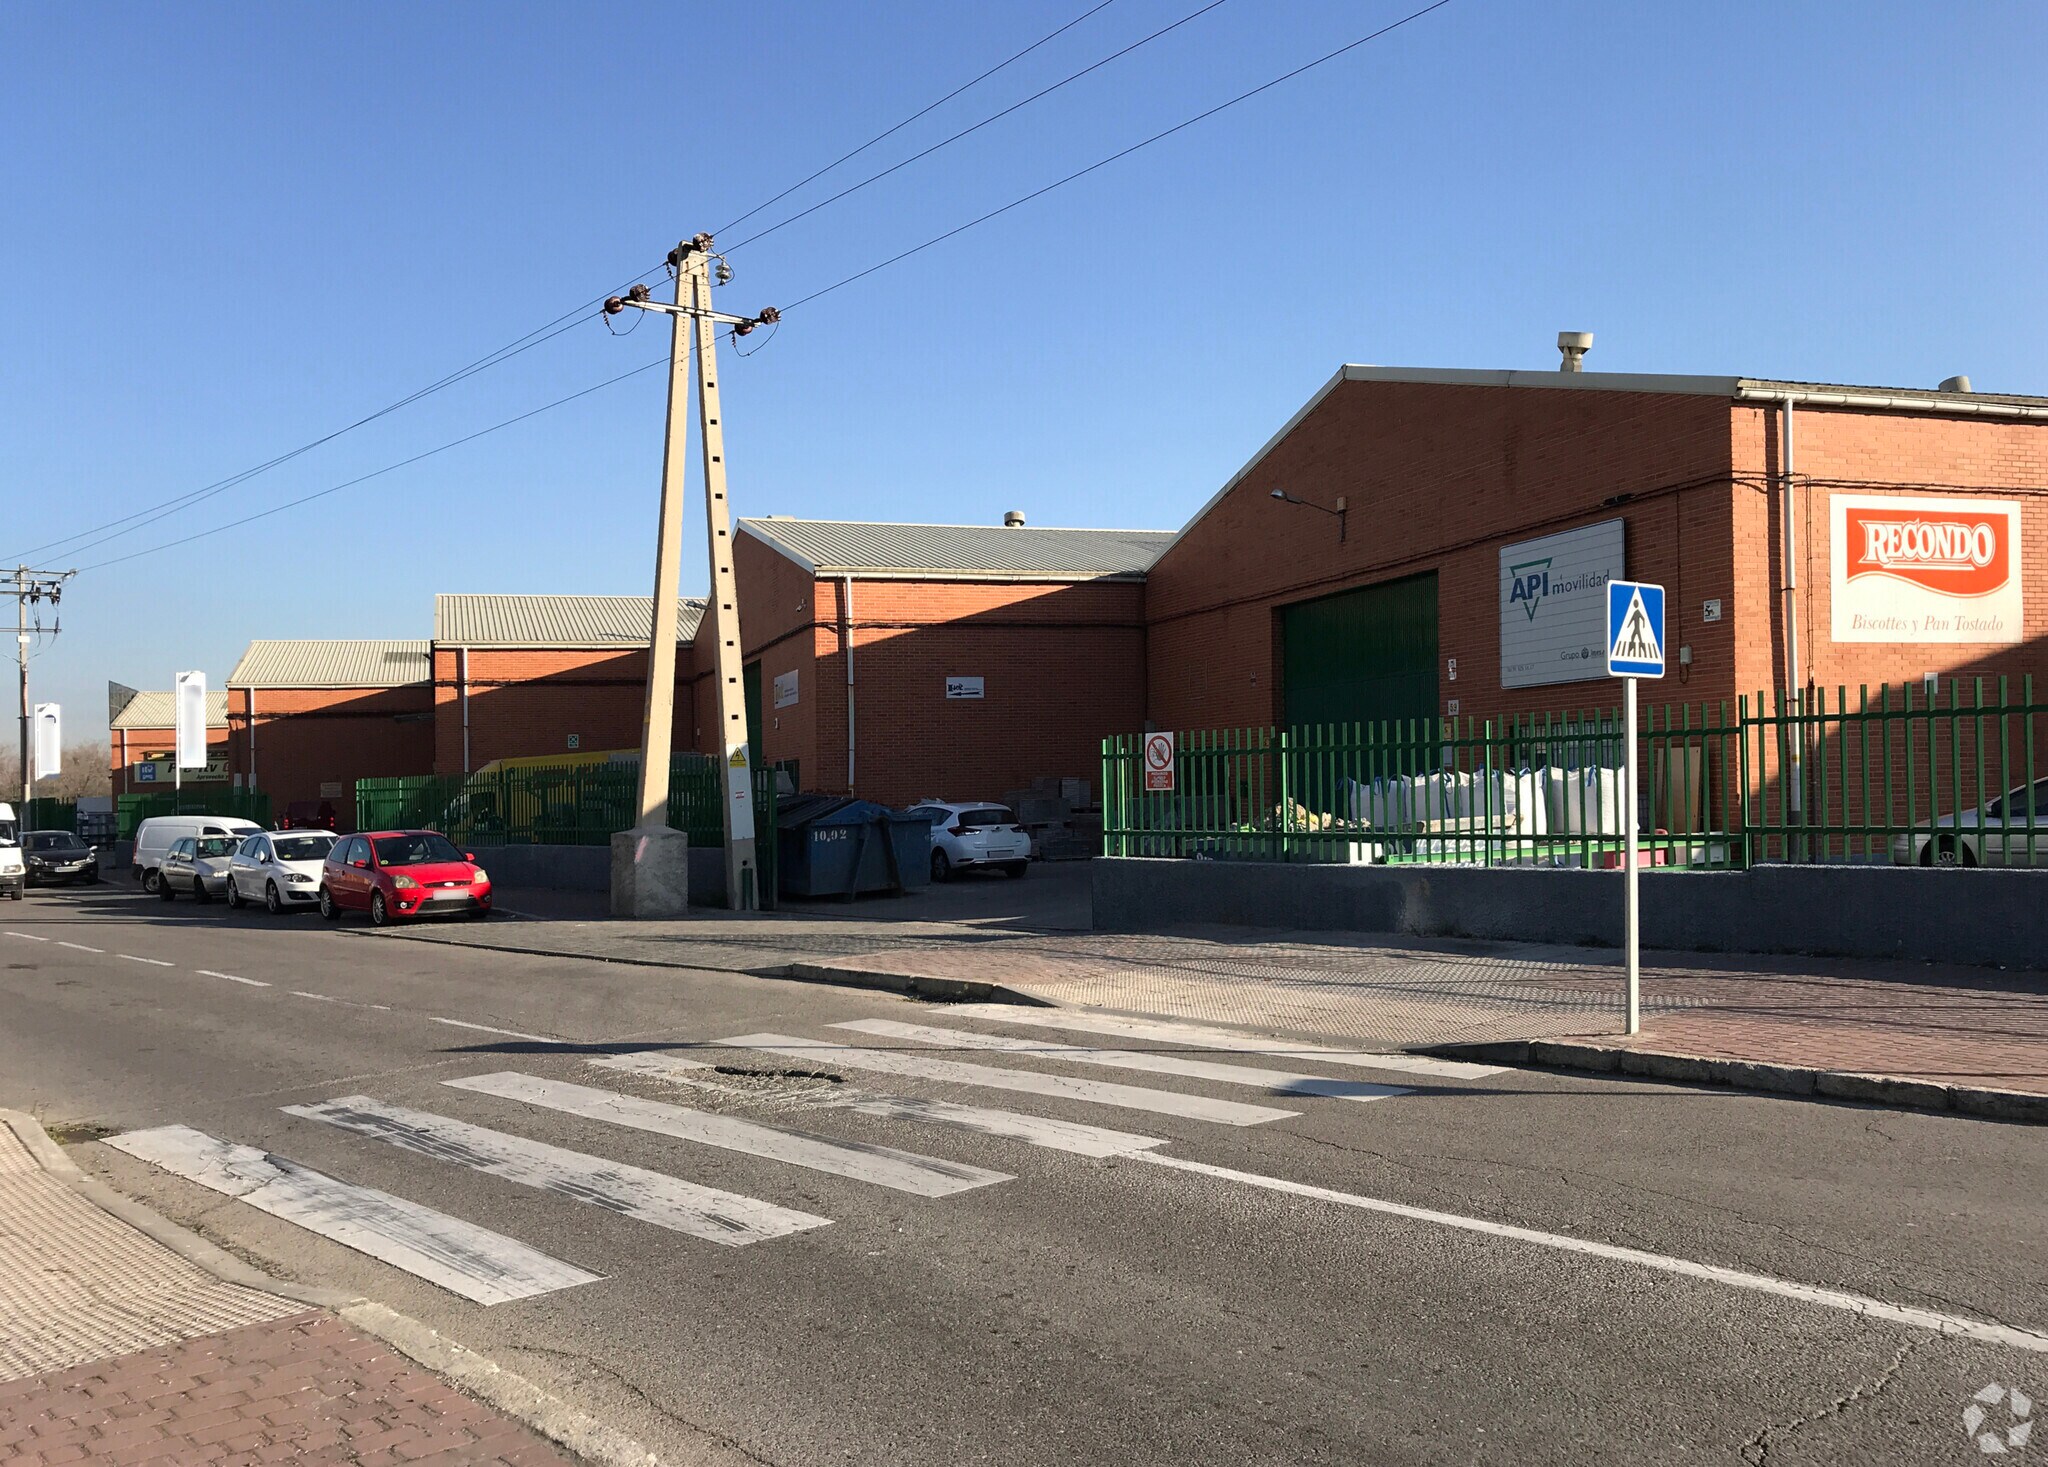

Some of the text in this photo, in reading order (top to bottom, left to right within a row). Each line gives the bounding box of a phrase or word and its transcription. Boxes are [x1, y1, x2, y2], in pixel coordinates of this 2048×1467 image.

[1858, 519, 1996, 567] RECONDO
[1509, 570, 1610, 604] API movilidad
[1852, 613, 2004, 636] Biscottes y Pan Tostado
[1560, 651, 1580, 661] Grupo
